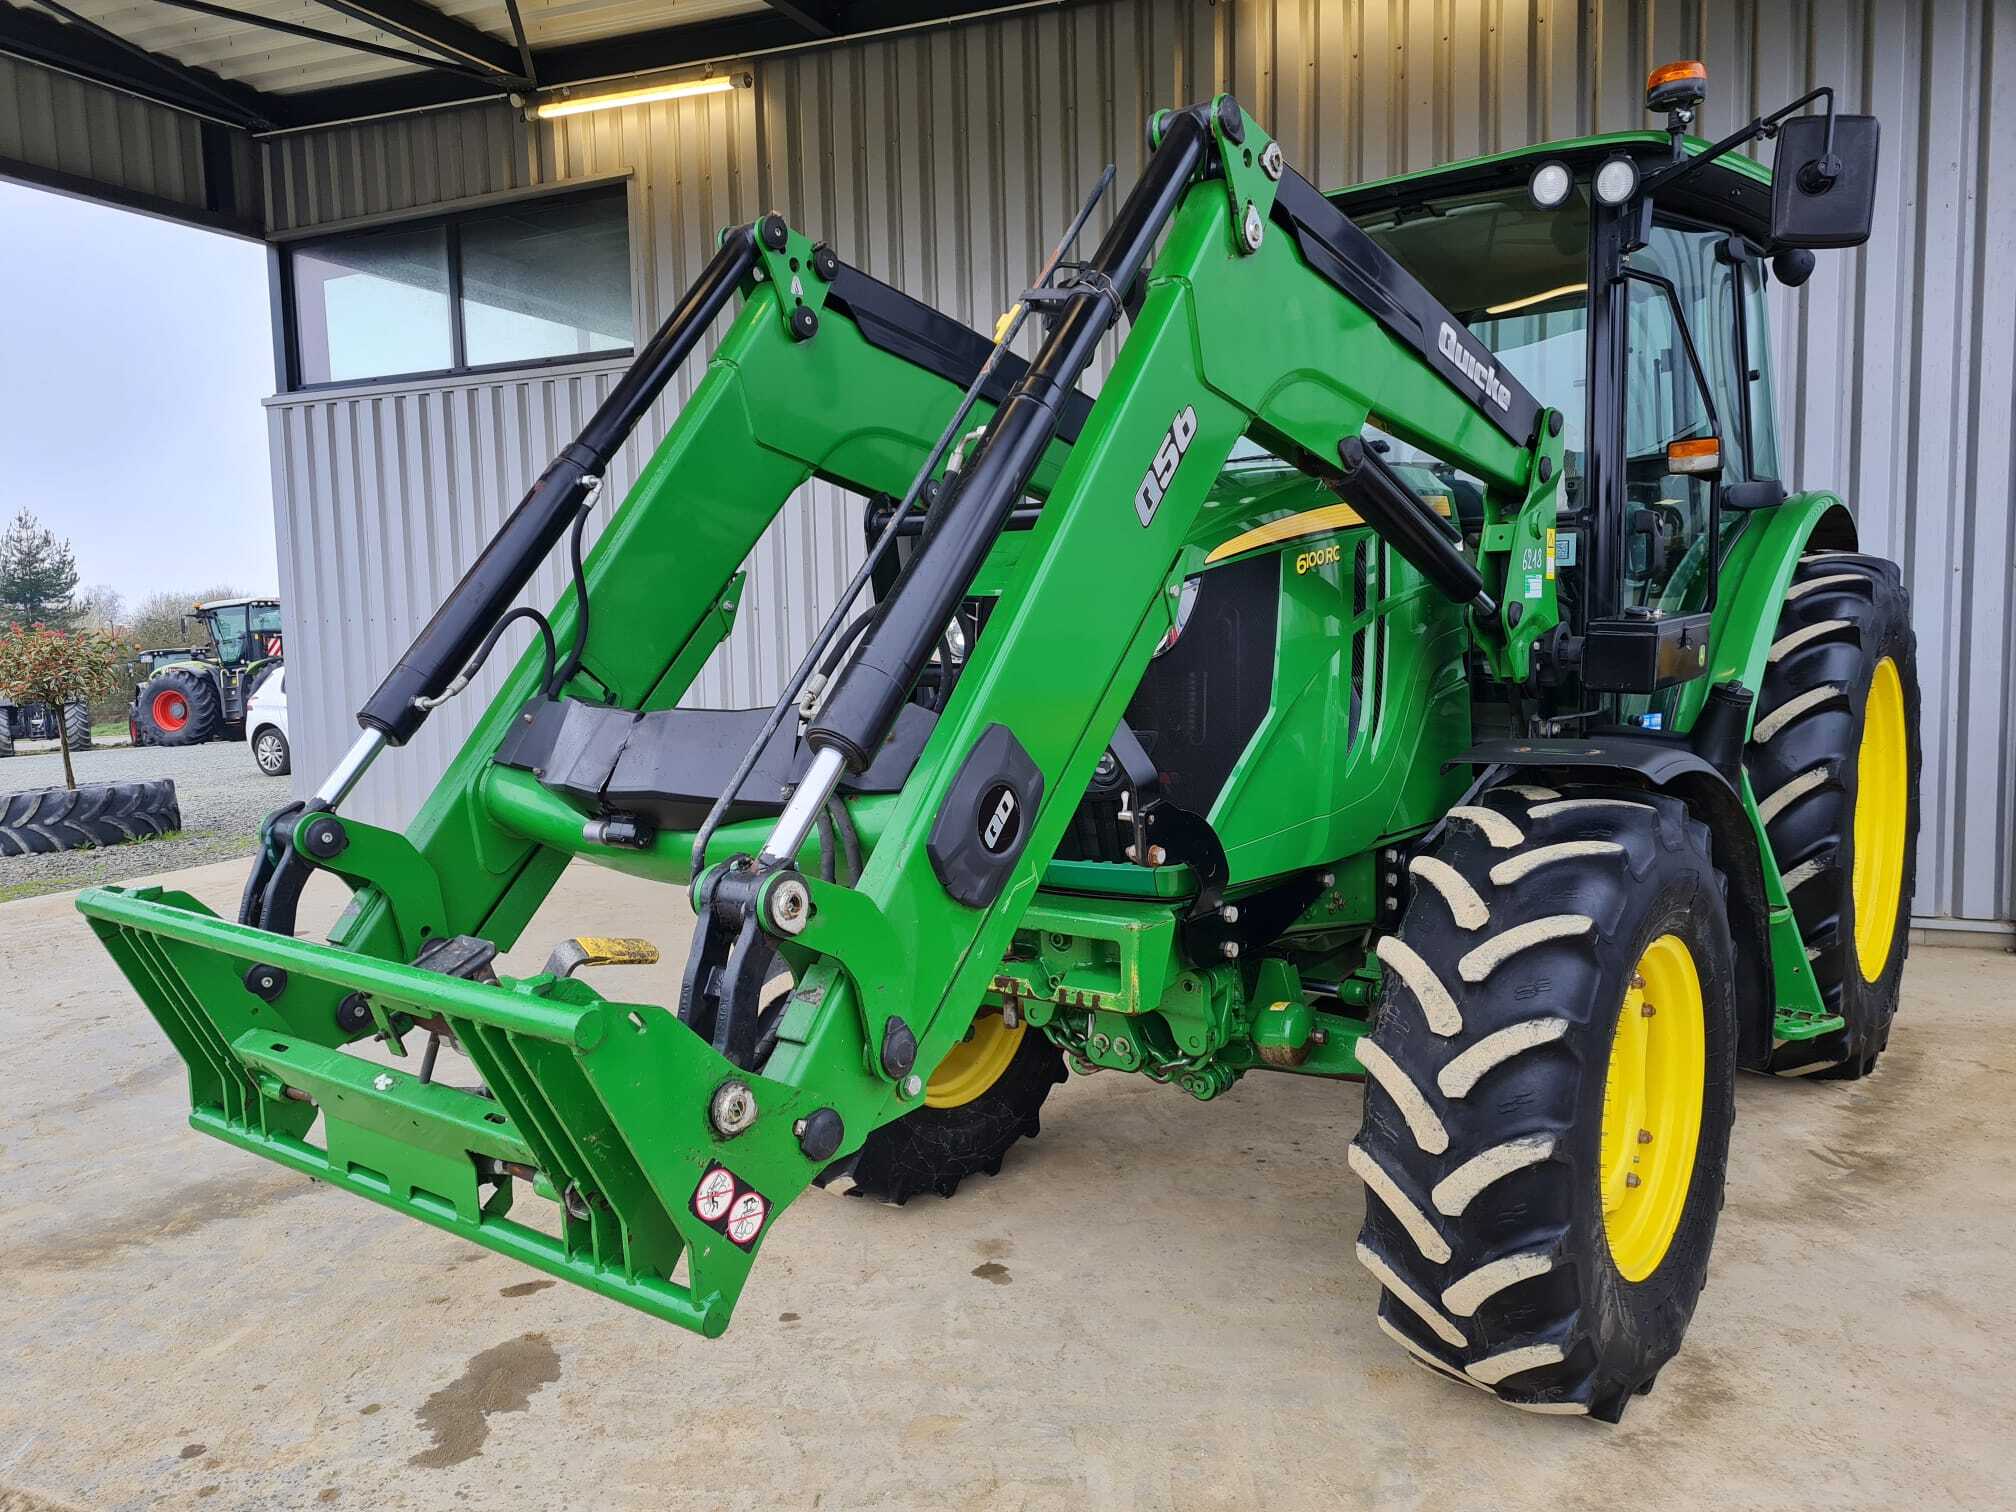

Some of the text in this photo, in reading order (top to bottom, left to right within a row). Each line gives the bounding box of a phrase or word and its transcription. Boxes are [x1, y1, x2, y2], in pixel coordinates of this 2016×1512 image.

[1438, 321, 1512, 412] Quicke
[1134, 405, 1198, 528] Q56
[1296, 544, 1341, 575] 6100RC
